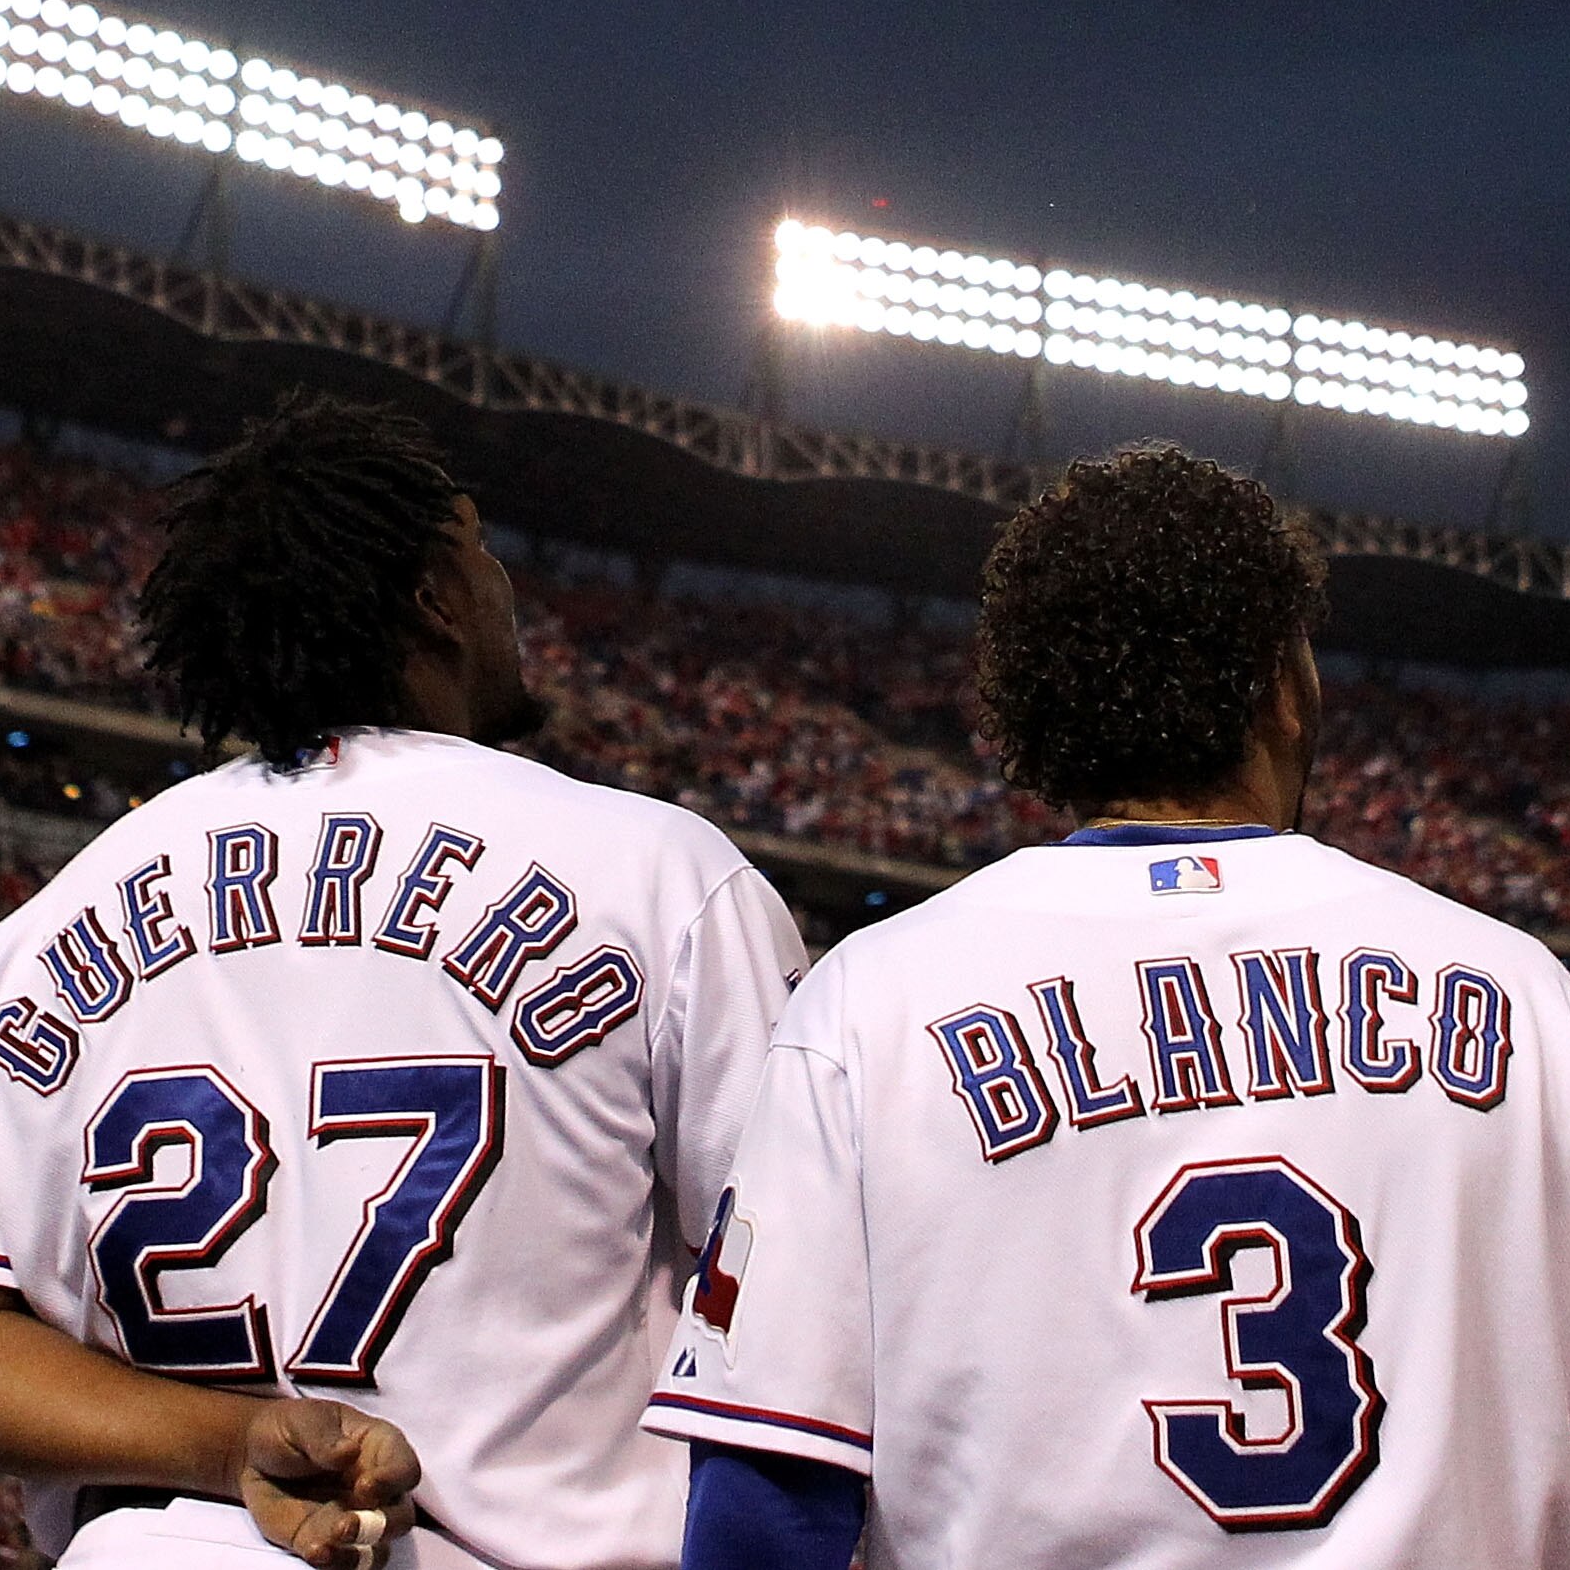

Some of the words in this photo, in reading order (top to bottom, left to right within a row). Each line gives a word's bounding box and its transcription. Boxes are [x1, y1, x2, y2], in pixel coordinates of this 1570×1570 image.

[81, 1054, 507, 1388] 27
[929, 946, 1513, 1163] BLANCO
[1129, 1155, 1387, 1533] 3
